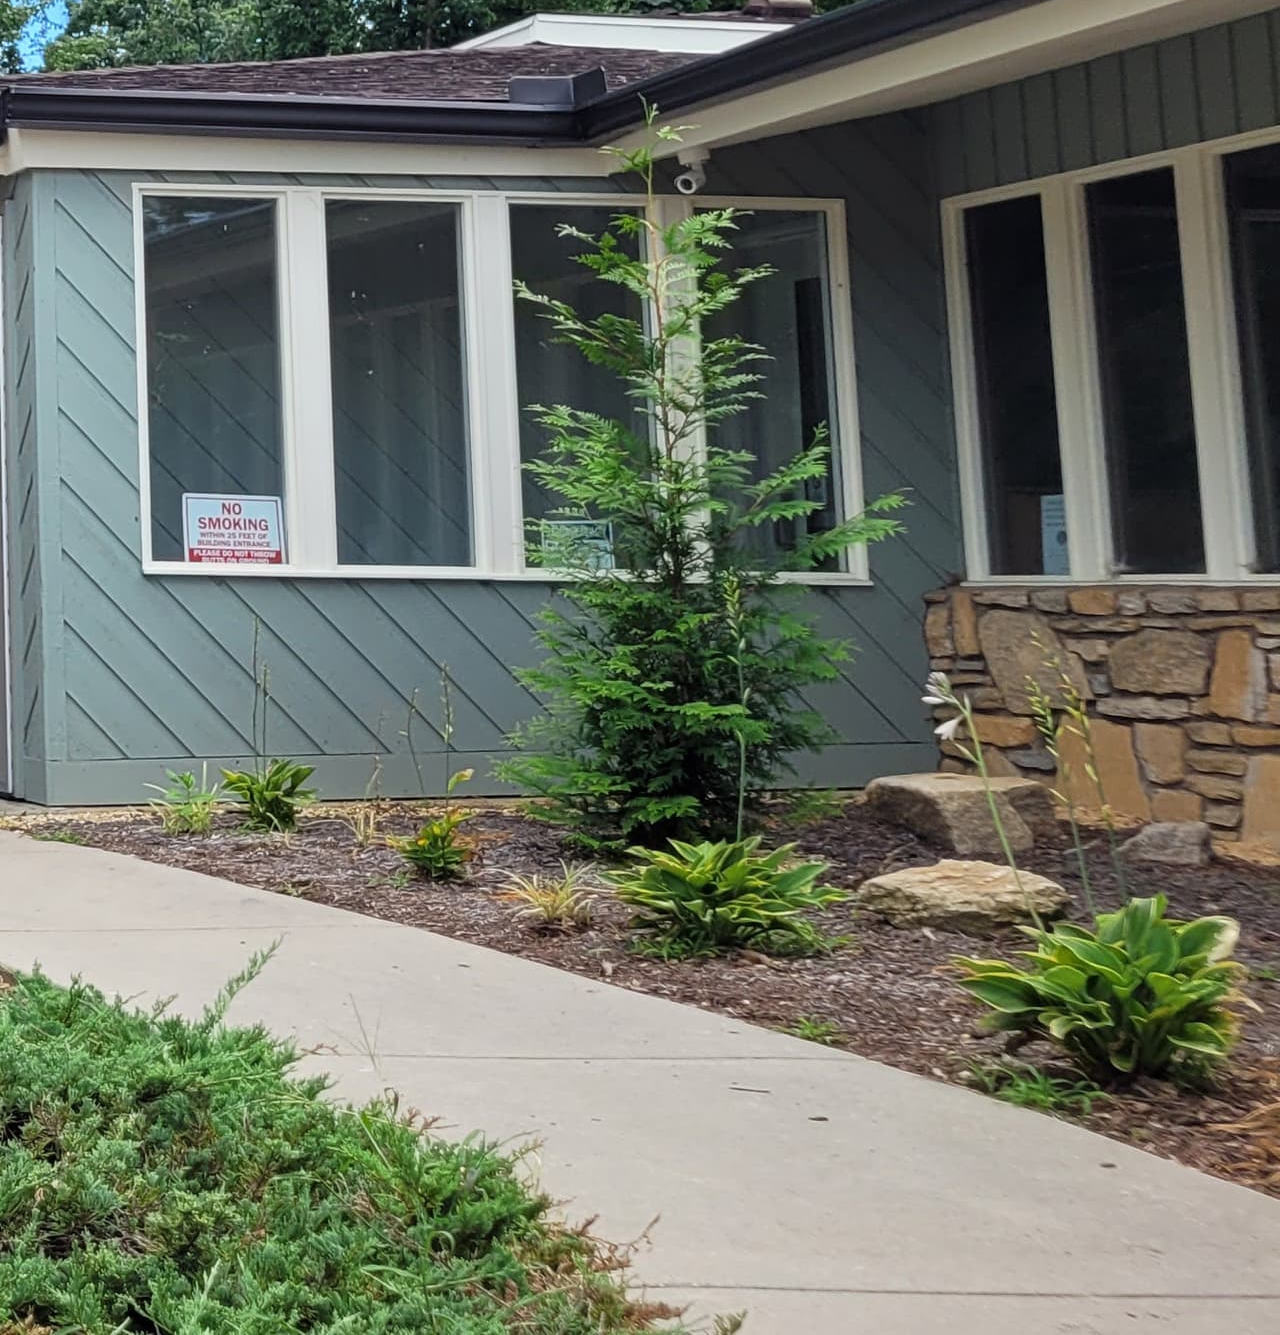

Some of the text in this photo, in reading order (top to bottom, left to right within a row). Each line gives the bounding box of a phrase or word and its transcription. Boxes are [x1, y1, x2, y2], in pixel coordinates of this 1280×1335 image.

[221, 502, 242, 515] NO
[198, 516, 269, 531] SMOKING
[197, 539, 271, 548] BUILDING ENTRANCE
[193, 549, 220, 557] PLEASE
